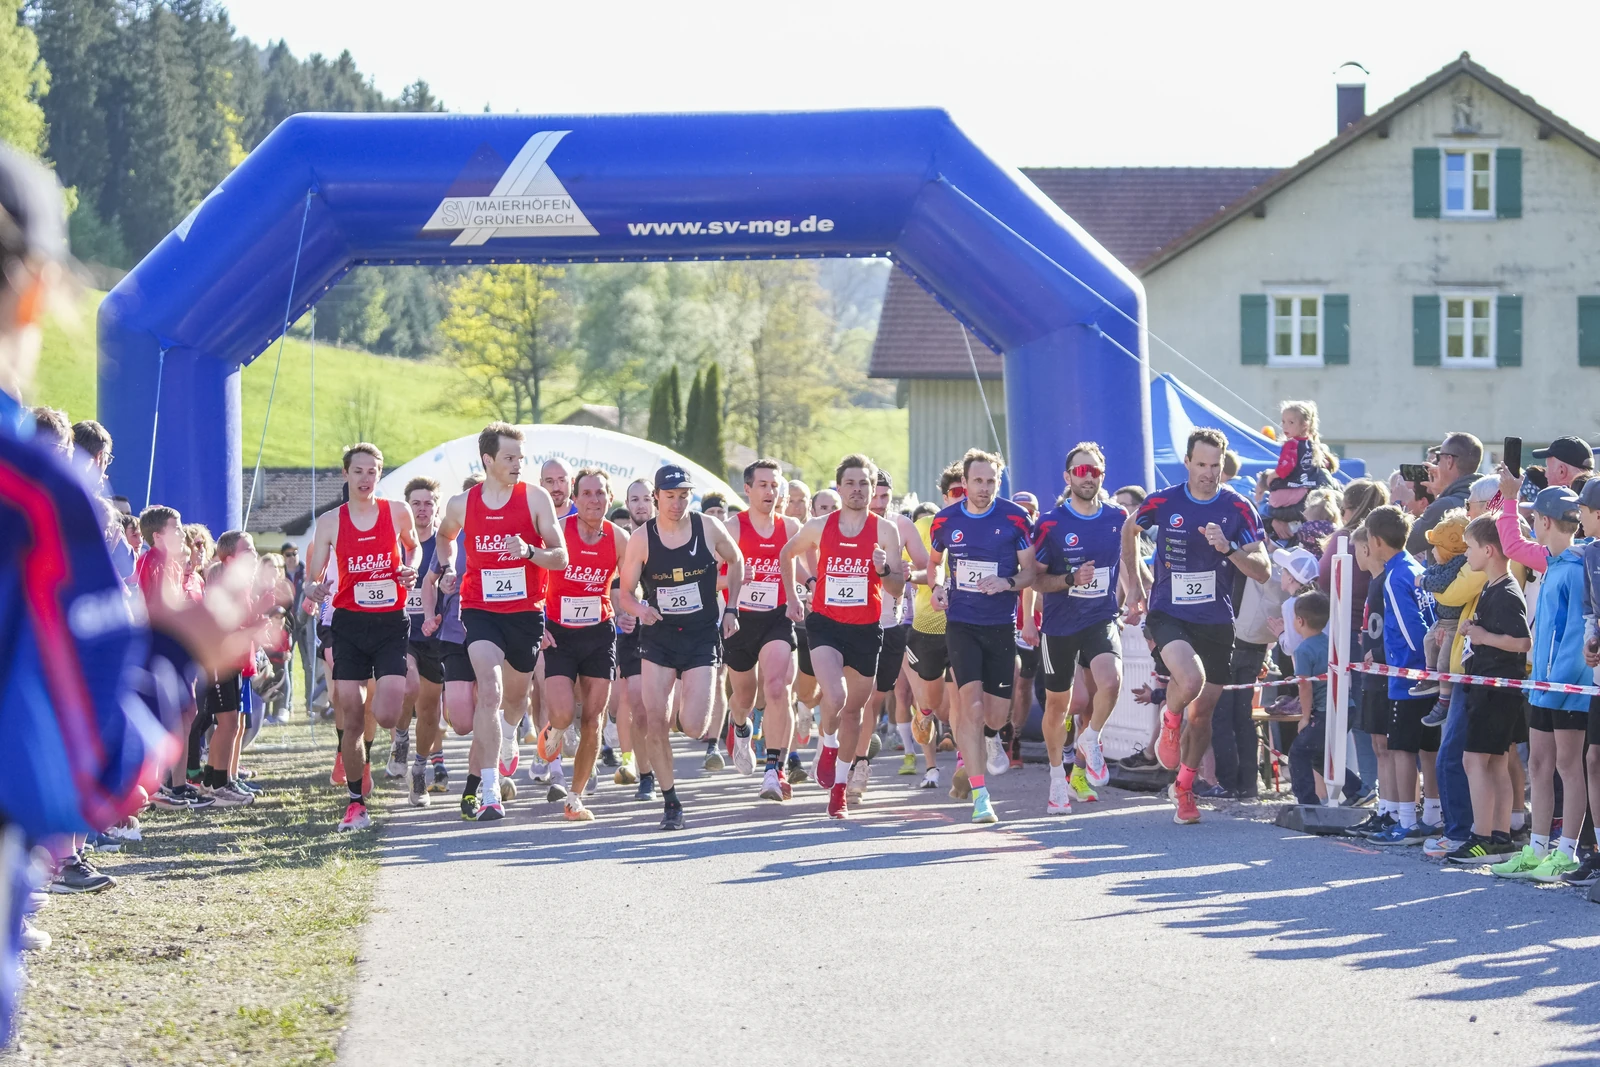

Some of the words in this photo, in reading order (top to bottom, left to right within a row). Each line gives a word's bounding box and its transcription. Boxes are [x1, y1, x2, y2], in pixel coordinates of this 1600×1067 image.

[475, 197, 571, 211] MAIERHÖFEN
[442, 200, 475, 226] SV
[473, 213, 575, 226] GRÜNENBACH
[628, 215, 834, 237] www.sv-mg.de
[348, 552, 392, 565] SPORT
[745, 557, 780, 567] SPOR
[827, 556, 871, 567] SPORT
[348, 559, 392, 572] HASCHKO
[566, 564, 609, 576] SPORT
[826, 564, 870, 574] HASCHKO
[564, 571, 607, 583] HASCHKO
[495, 579, 513, 592] 24
[1186, 582, 1202, 595] 32
[368, 589, 384, 600] 38
[750, 591, 766, 603] 67
[838, 587, 854, 598] 42
[407, 596, 422, 607] 43
[670, 595, 687, 608] 28
[574, 606, 589, 618] 77
